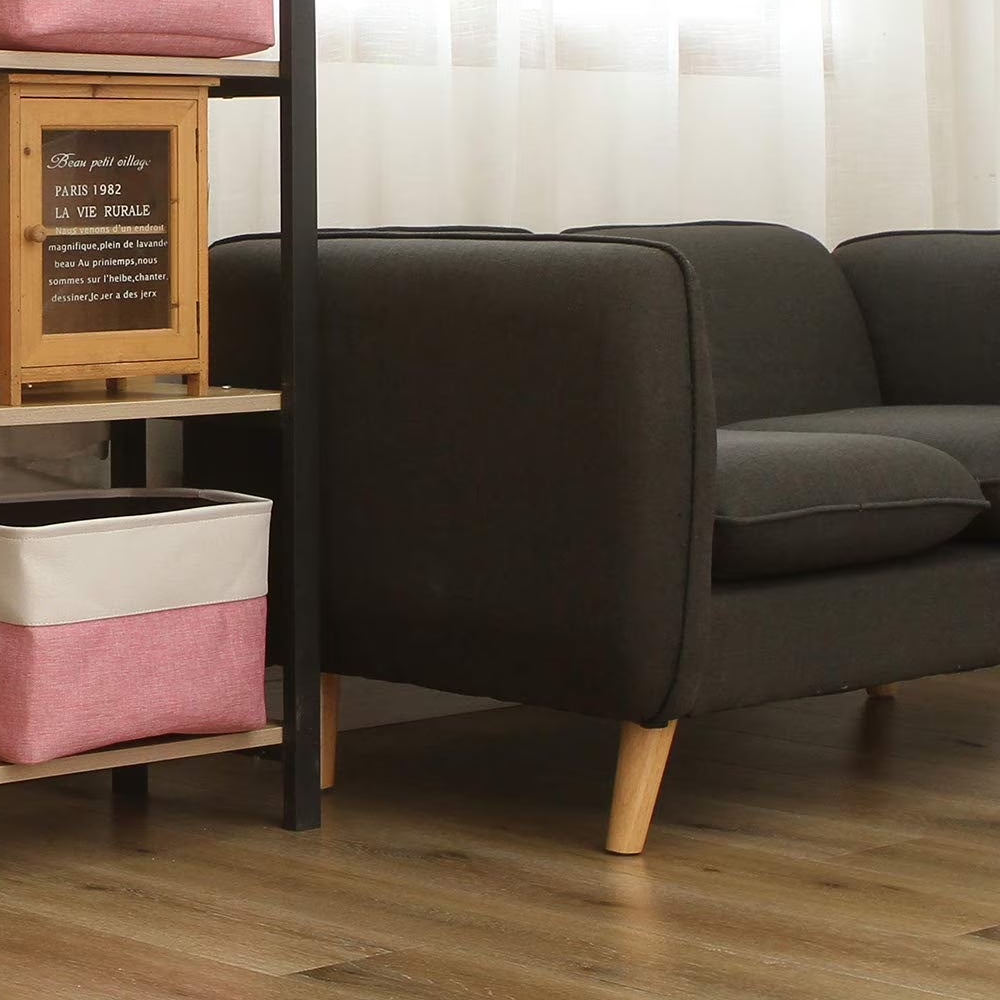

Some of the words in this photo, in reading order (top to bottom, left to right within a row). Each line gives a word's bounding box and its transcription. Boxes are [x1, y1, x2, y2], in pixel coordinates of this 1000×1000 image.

[47, 153, 86, 169] Beau
[89, 156, 115, 172] petit
[55, 184, 88, 197] PARIS
[93, 184, 122, 195] 1982
[55, 207, 70, 218] LA
[77, 206, 97, 218] VIE
[104, 204, 151, 217] RURALE
[79, 226, 110, 234] venons
[112, 224, 131, 233] d'un
[134, 223, 164, 232] endroit
[48, 240, 121, 253] magnifique,plein
[123, 240, 134, 249] de
[136, 238, 168, 248] lavande
[54, 259, 75, 268] beau
[77, 258, 90, 267] Au
[48, 276, 85, 286] sommes
[123, 290, 138, 299] des
